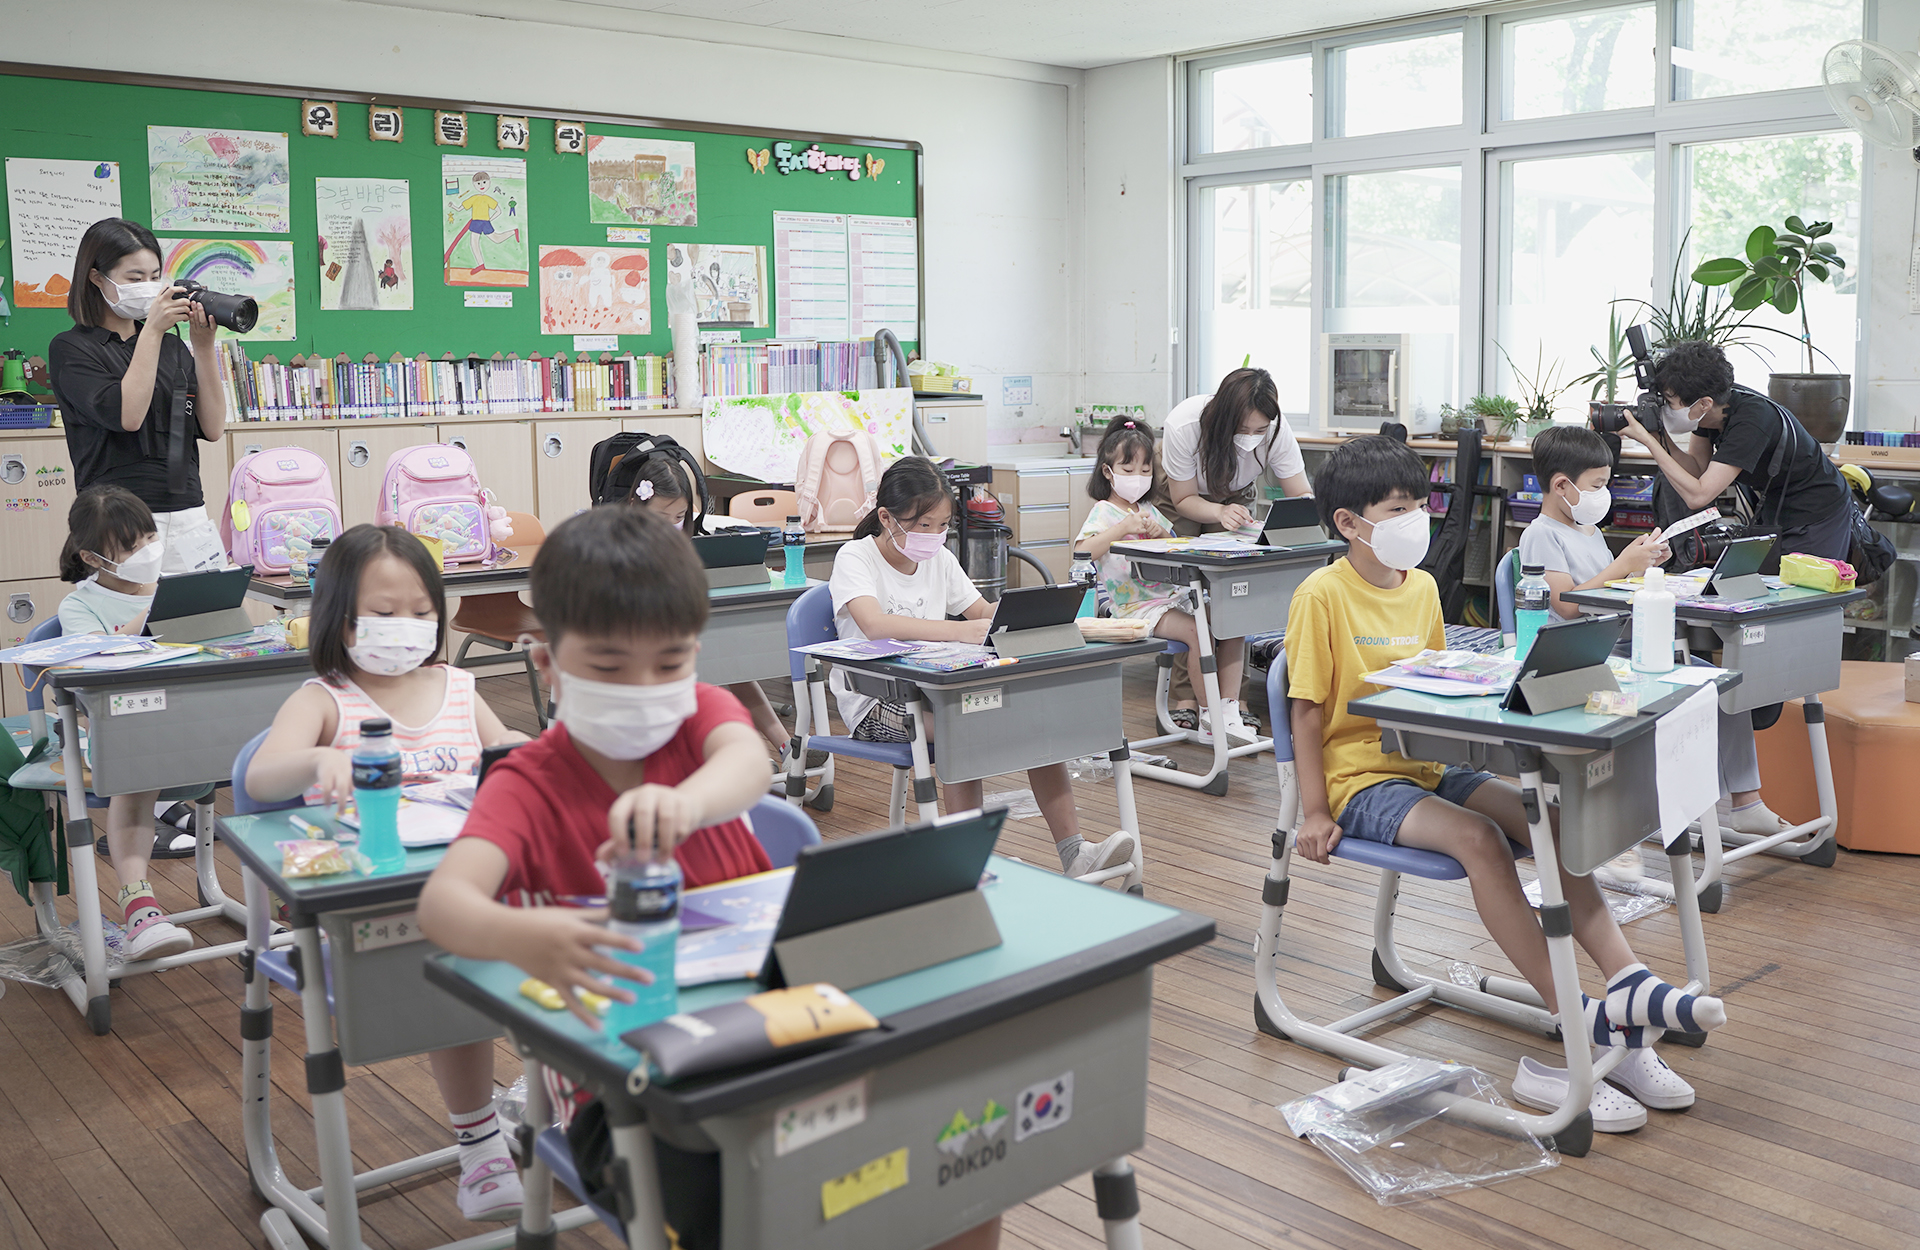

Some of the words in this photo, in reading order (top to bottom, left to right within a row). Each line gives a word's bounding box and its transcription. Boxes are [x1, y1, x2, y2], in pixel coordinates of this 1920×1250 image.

[335, 184, 386, 210] 봄바람
[38, 478, 66, 487] DOKDO
[1353, 636, 1390, 646] GROUND
[938, 1139, 1007, 1187] DOKDO
